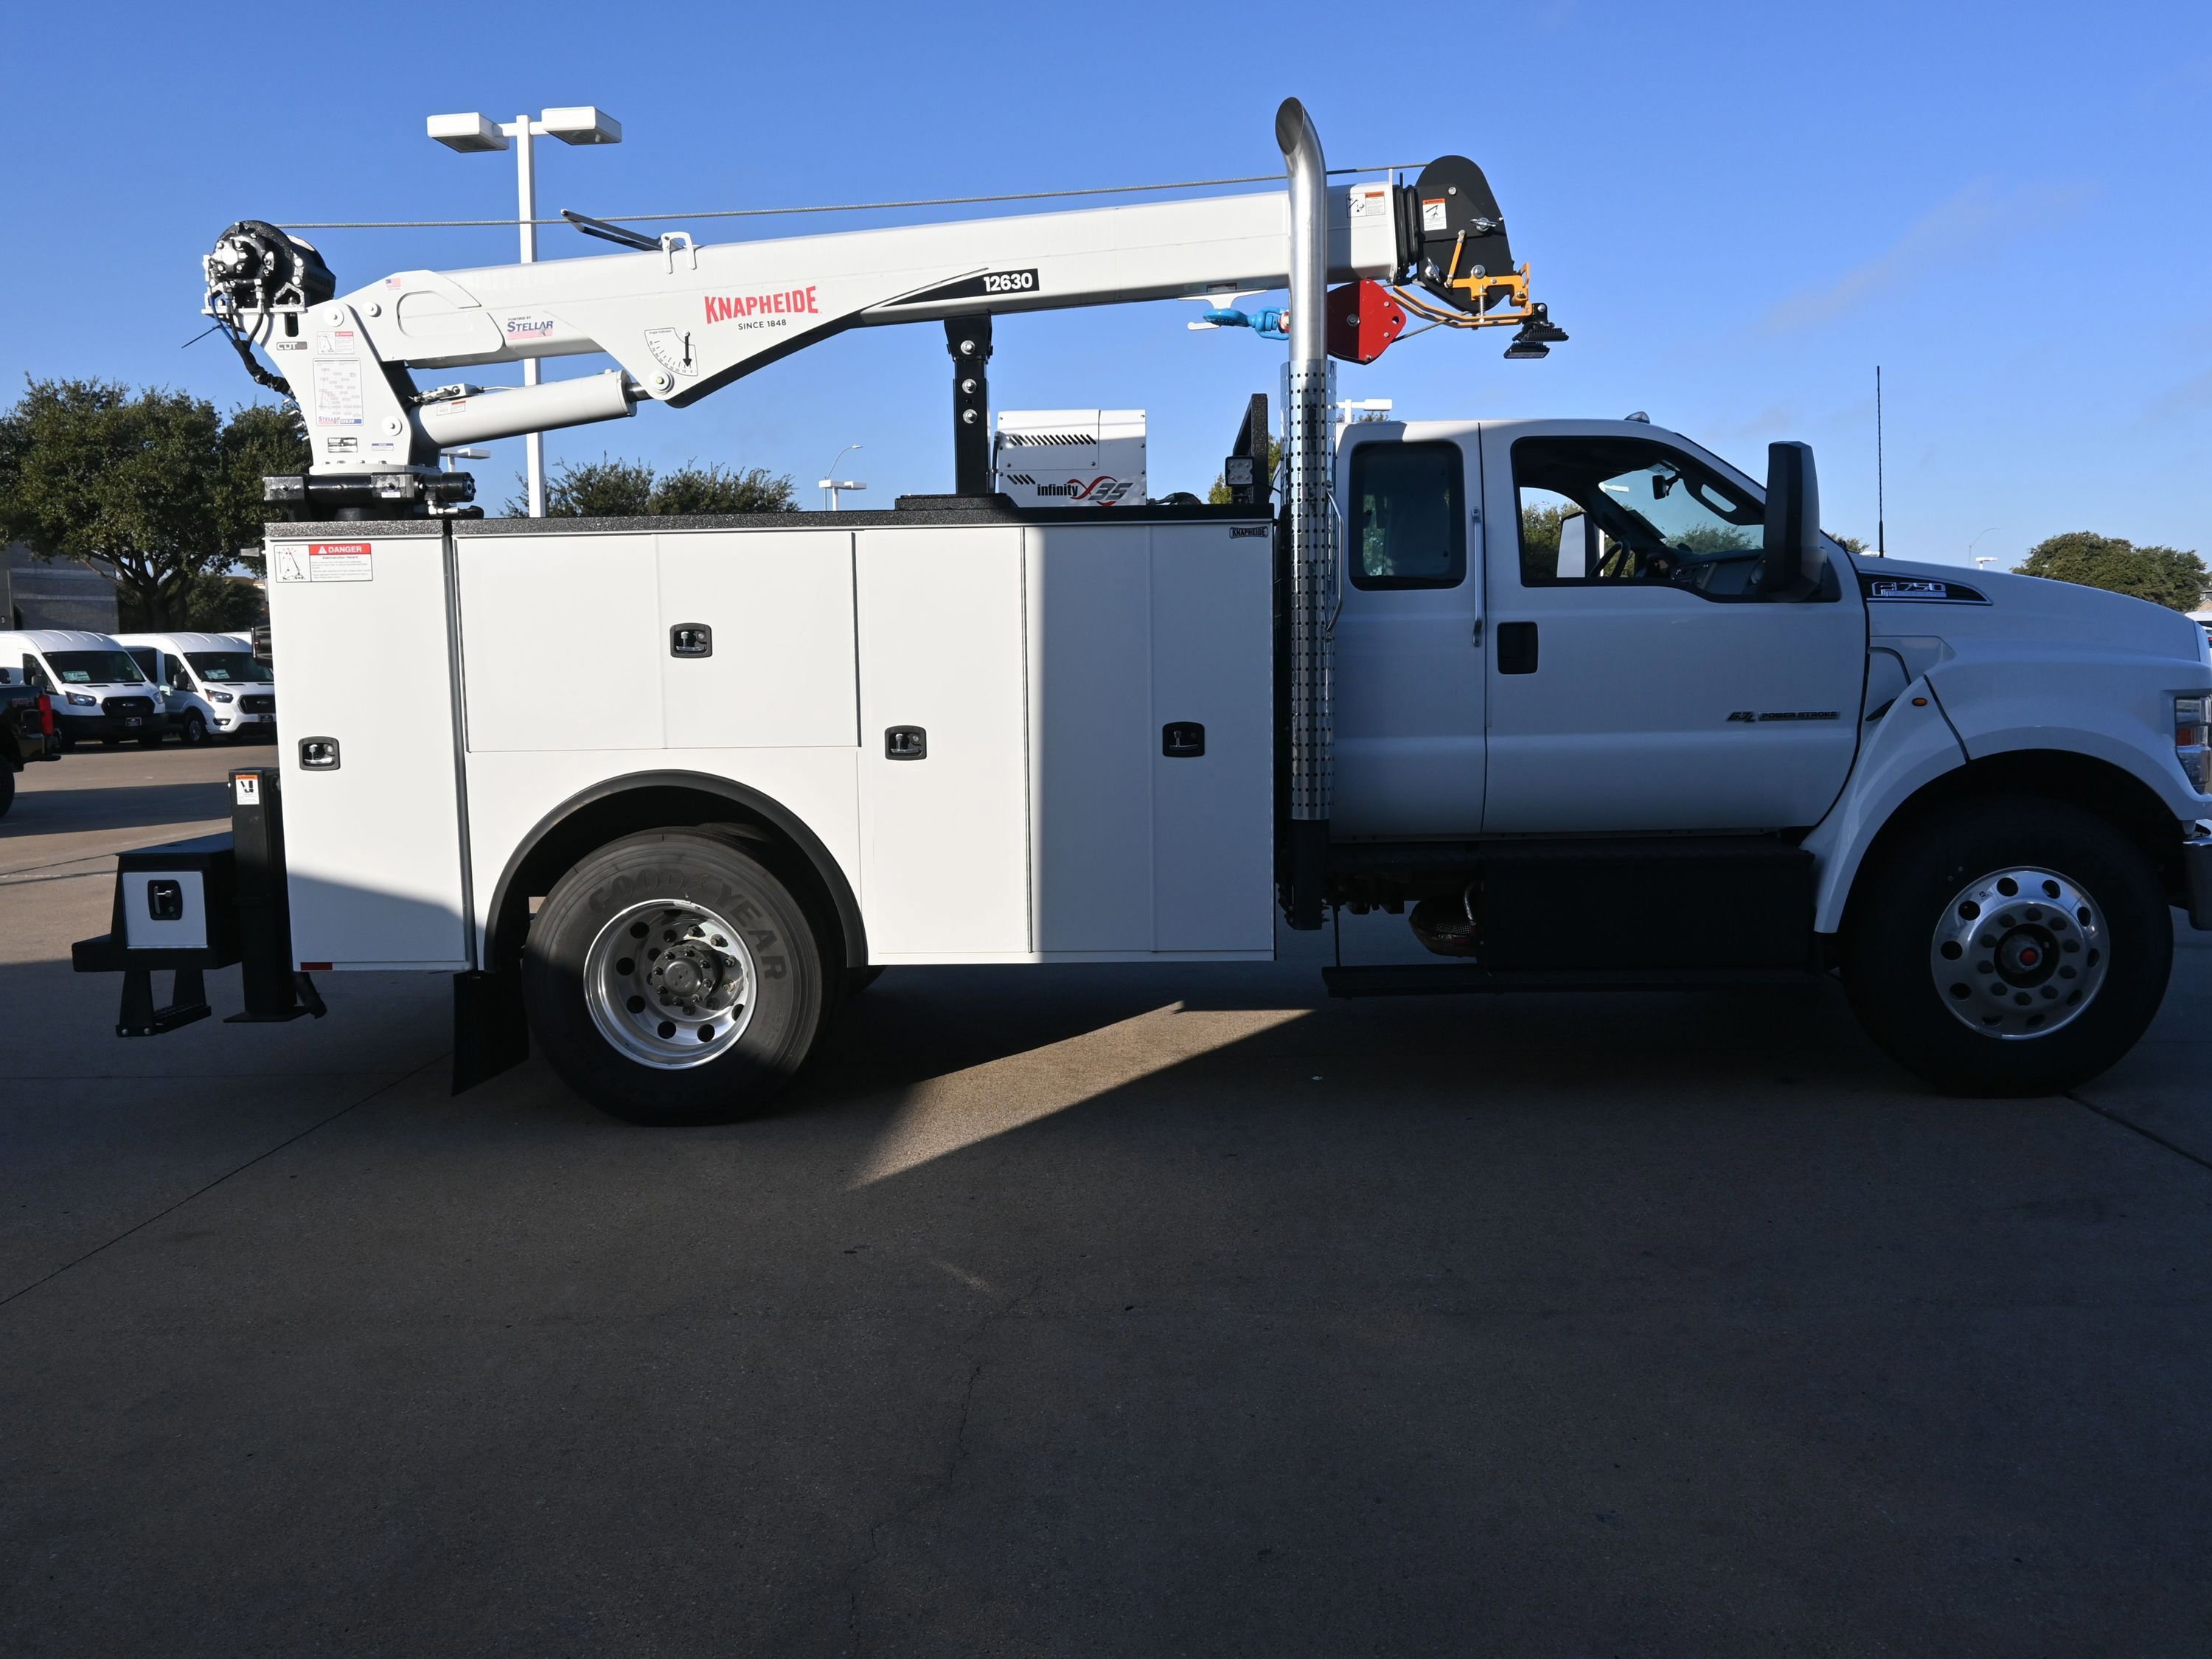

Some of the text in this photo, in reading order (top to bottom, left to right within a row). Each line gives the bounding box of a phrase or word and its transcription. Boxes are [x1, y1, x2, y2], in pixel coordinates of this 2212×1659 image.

[983, 272, 1033, 293] 12630
[704, 285, 818, 324] KNAPHEIDE
[507, 320, 554, 333] STELLAR
[738, 319, 787, 330] SINCE 1848
[1037, 482, 1134, 501] infinity 35
[1232, 526, 1267, 538] KNAPHEIDE
[328, 546, 362, 554] DANGER
